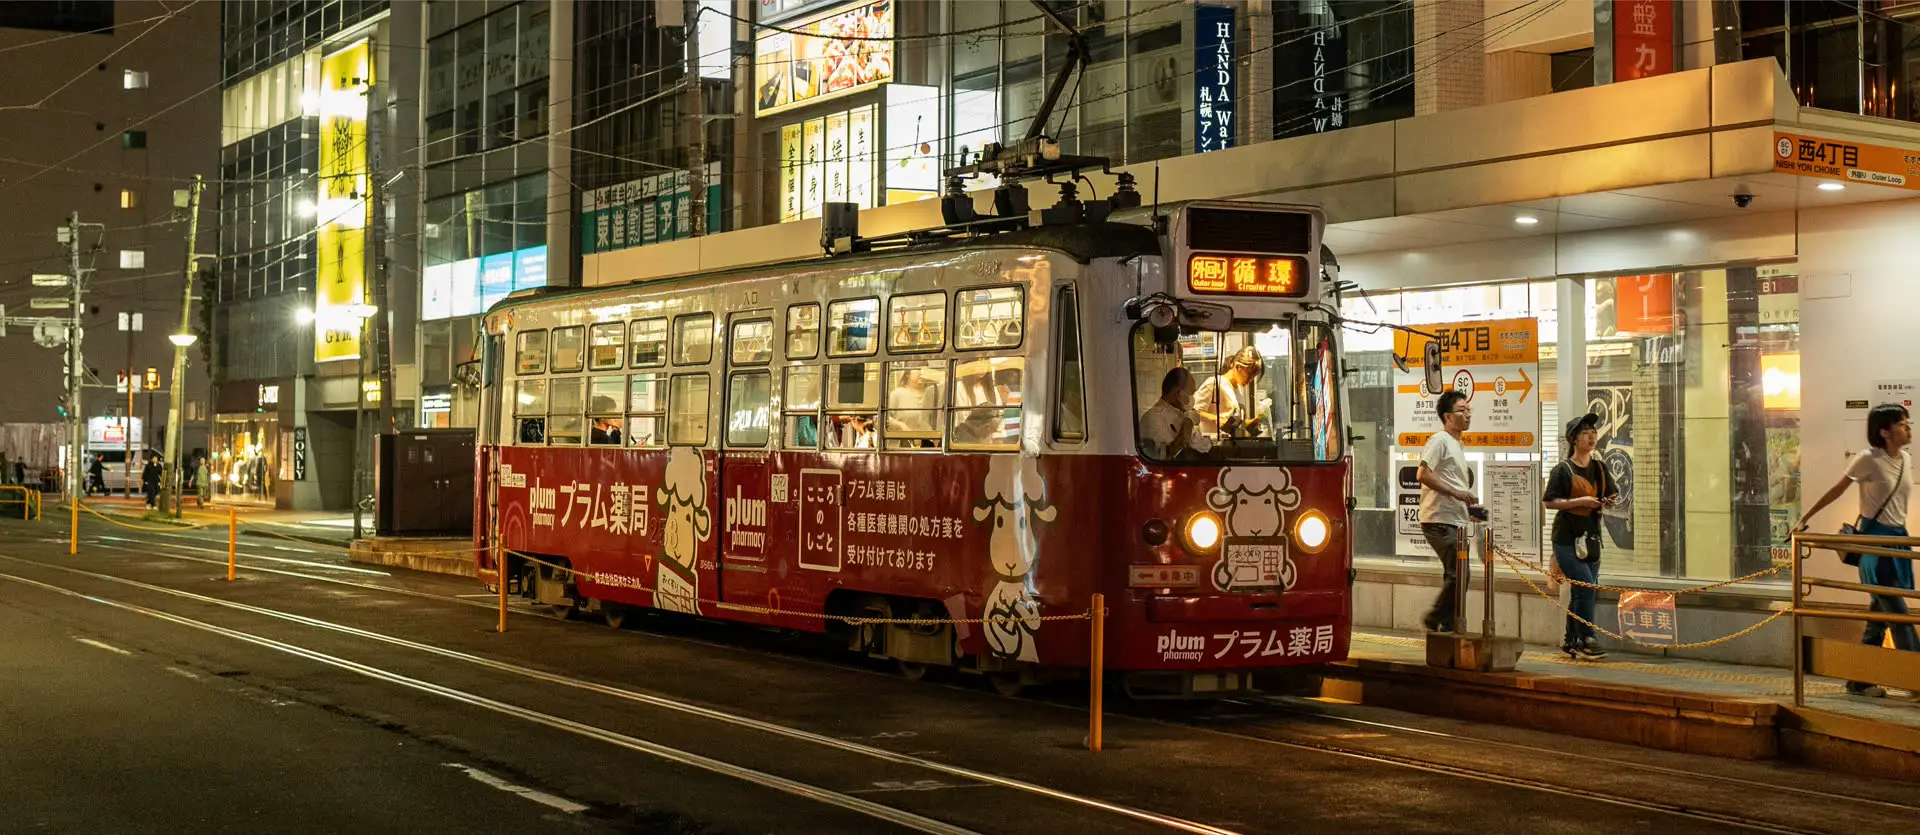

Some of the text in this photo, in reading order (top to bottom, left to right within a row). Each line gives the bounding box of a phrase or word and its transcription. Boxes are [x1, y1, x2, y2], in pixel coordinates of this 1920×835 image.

[1216, 22, 1230, 102] HANDA
[1798, 138, 1859, 168] 西4丁目
[1775, 159, 1841, 176] NISHI YON CHOME
[597, 196, 707, 248] 東進衛星予備
[325, 329, 352, 344] GYM
[1435, 326, 1490, 353] 西4丁目
[1457, 377, 1469, 388] SC
[295, 440, 305, 480] ONLY
[529, 476, 556, 515] plum
[807, 486, 834, 505] こころ
[847, 479, 907, 502] プラム薬局は
[559, 479, 649, 537] プラム薬局
[725, 484, 767, 532] plum
[816, 509, 824, 524] の
[847, 511, 964, 539] 各種医療機関の処方箋を
[731, 529, 766, 554] pharmacy
[807, 532, 833, 552] しごと
[847, 544, 936, 572] 受け付けております
[1157, 629, 1205, 653] plum
[1213, 624, 1334, 660] プラム薬局
[1163, 648, 1204, 662] pharmacy
